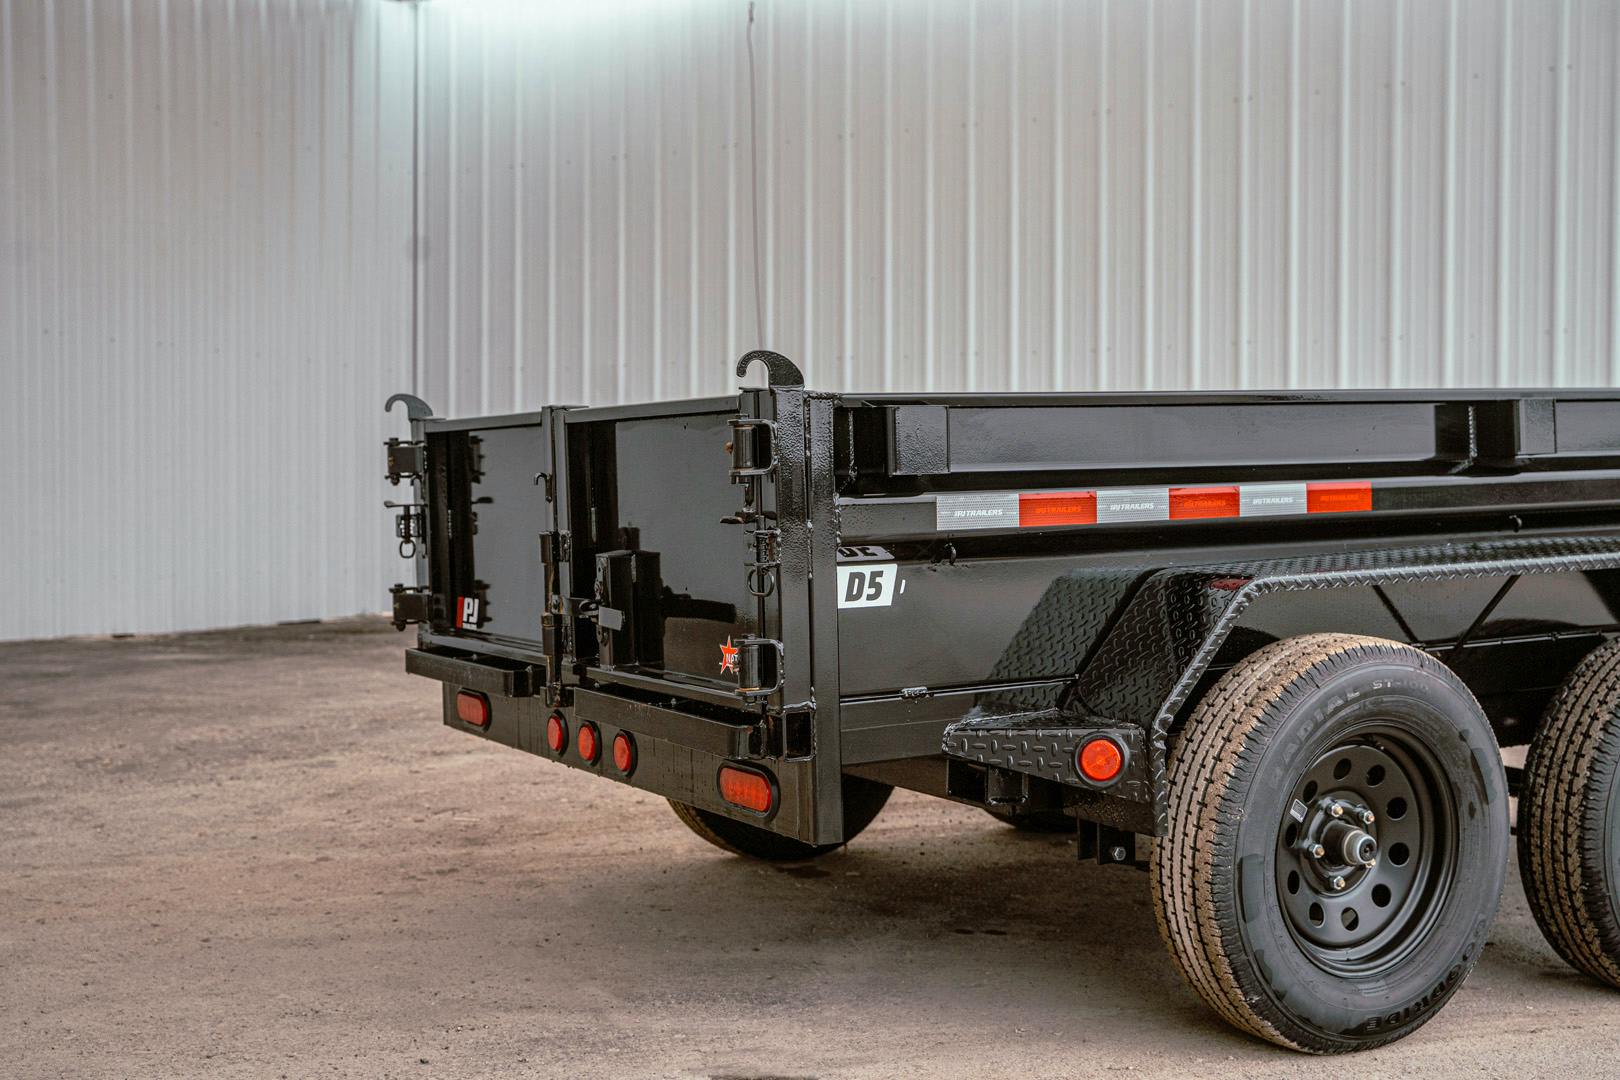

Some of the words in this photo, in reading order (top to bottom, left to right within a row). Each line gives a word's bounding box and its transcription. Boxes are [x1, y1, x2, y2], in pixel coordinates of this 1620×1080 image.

[966, 508, 1003, 517] TRAILERS
[845, 570, 884, 603] D5
[462, 597, 480, 624] PJ
